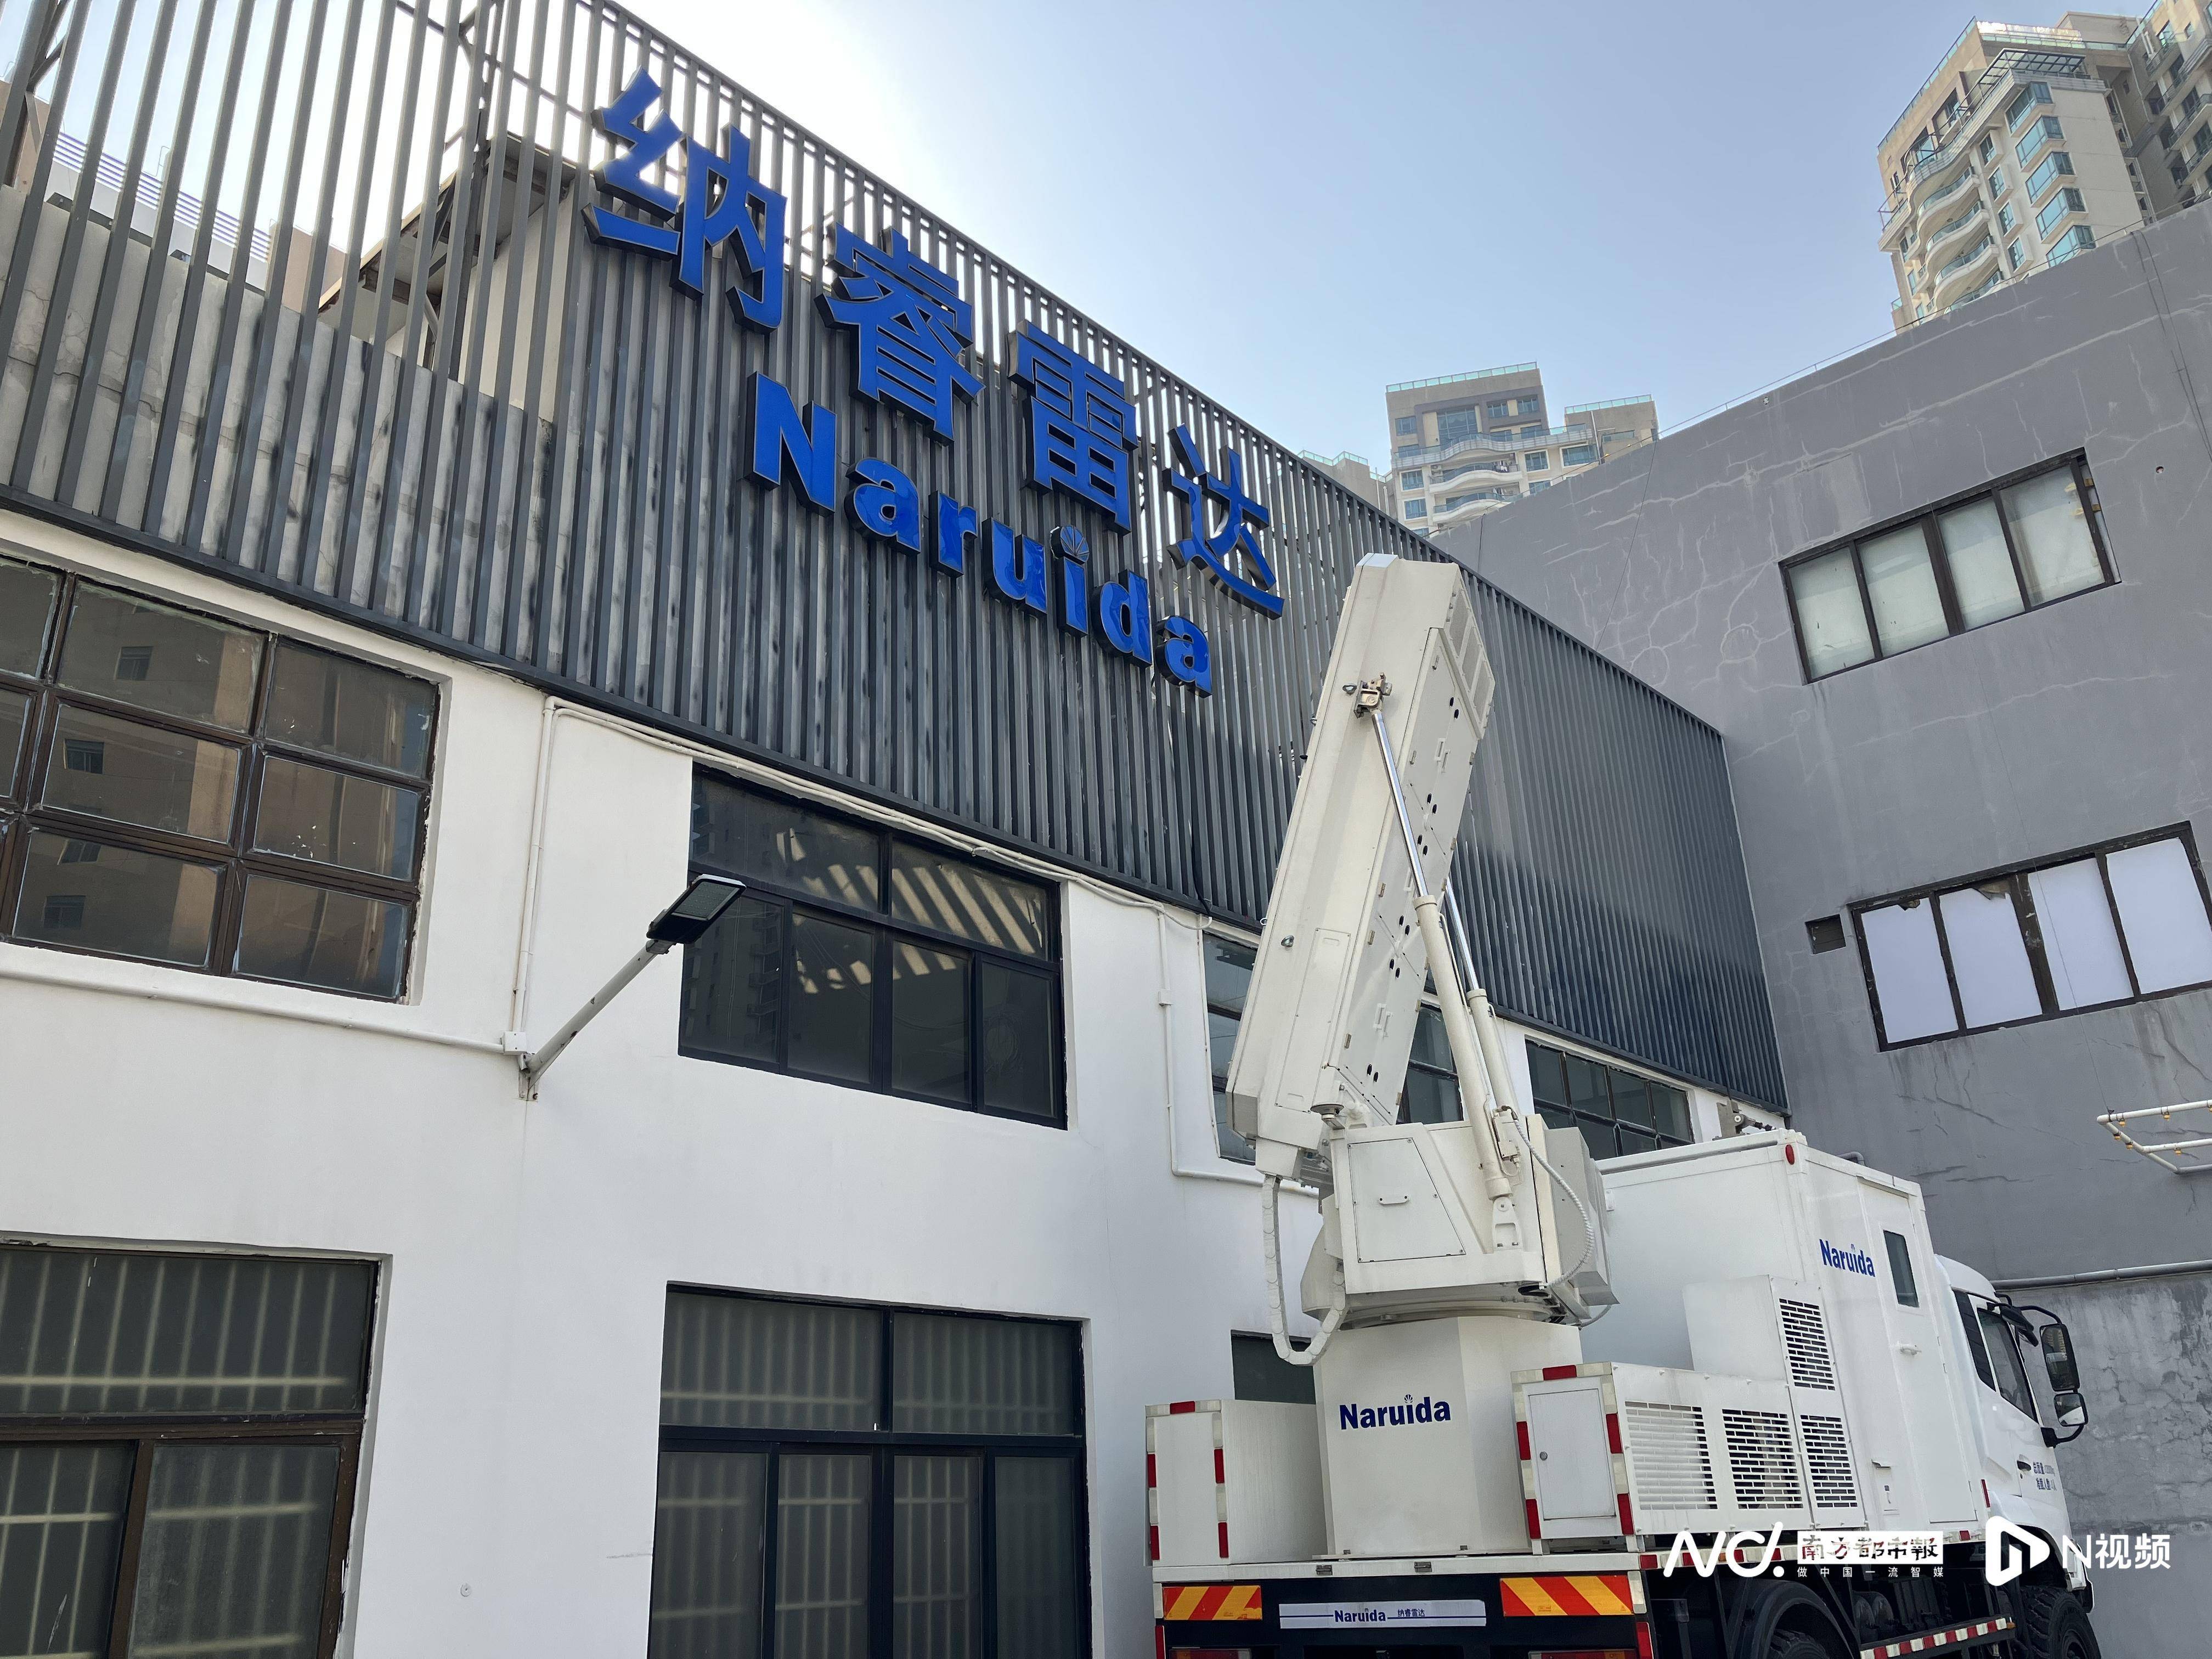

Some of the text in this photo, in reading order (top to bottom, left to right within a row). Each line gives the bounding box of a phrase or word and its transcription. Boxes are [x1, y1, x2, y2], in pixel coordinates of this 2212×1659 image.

[583, 66, 1285, 620] 纳睿雷达
[746, 371, 1214, 697] Naruida
[1819, 1239, 1876, 1277] Naruida
[1339, 1394, 1452, 1430] Naruida
[1334, 1608, 1425, 1622] Naruida 纳睿雷达
